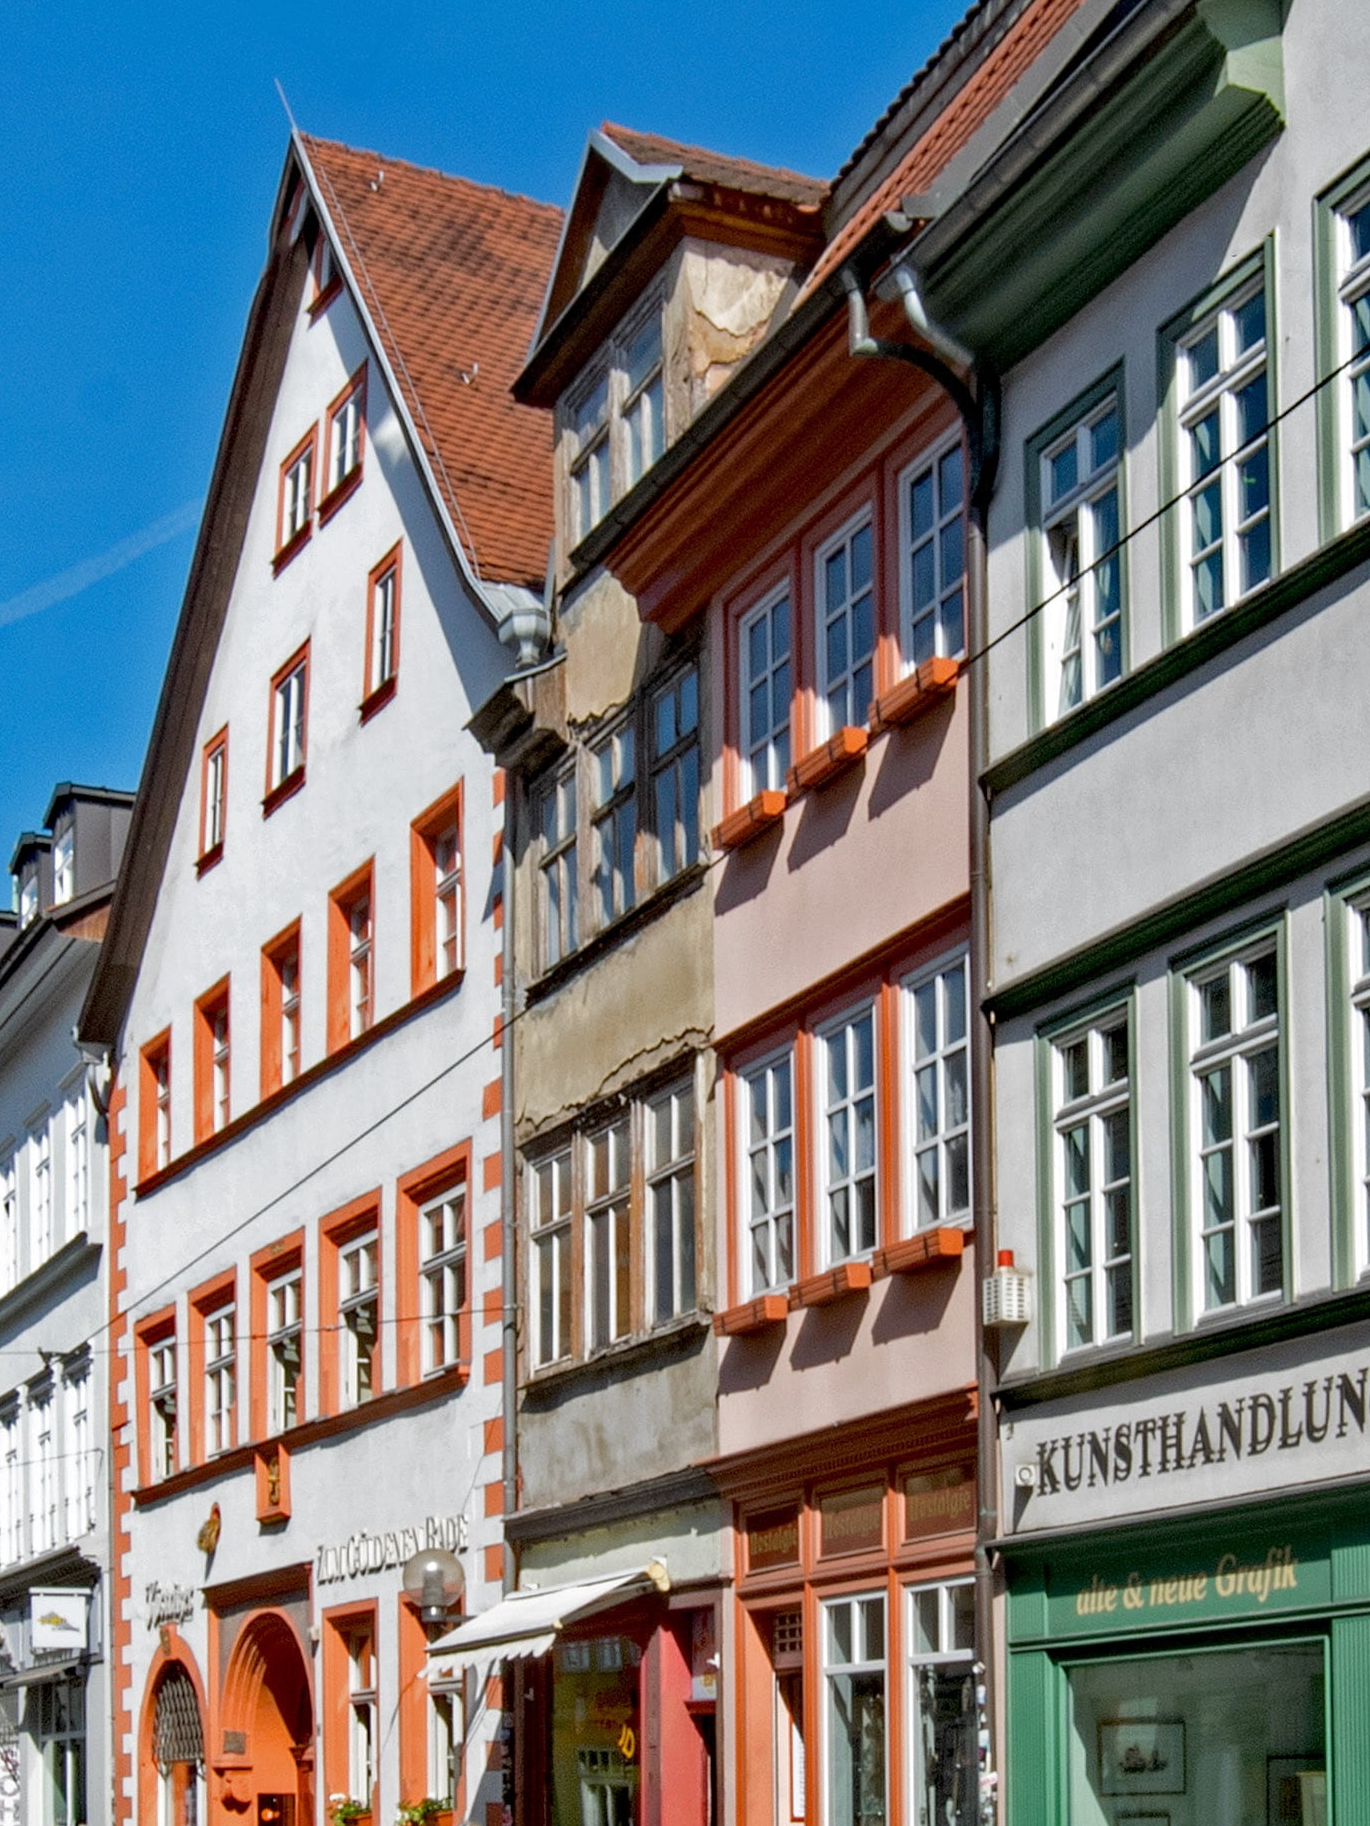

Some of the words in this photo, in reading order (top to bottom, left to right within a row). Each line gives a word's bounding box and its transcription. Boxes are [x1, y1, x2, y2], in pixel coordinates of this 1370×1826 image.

[909, 1489, 971, 1522] Nostalgie
[1076, 1573, 1118, 1616] alte
[1122, 1572, 1145, 1611] &
[1149, 1572, 1208, 1607] neue
[1215, 1544, 1298, 1604] Grafik
